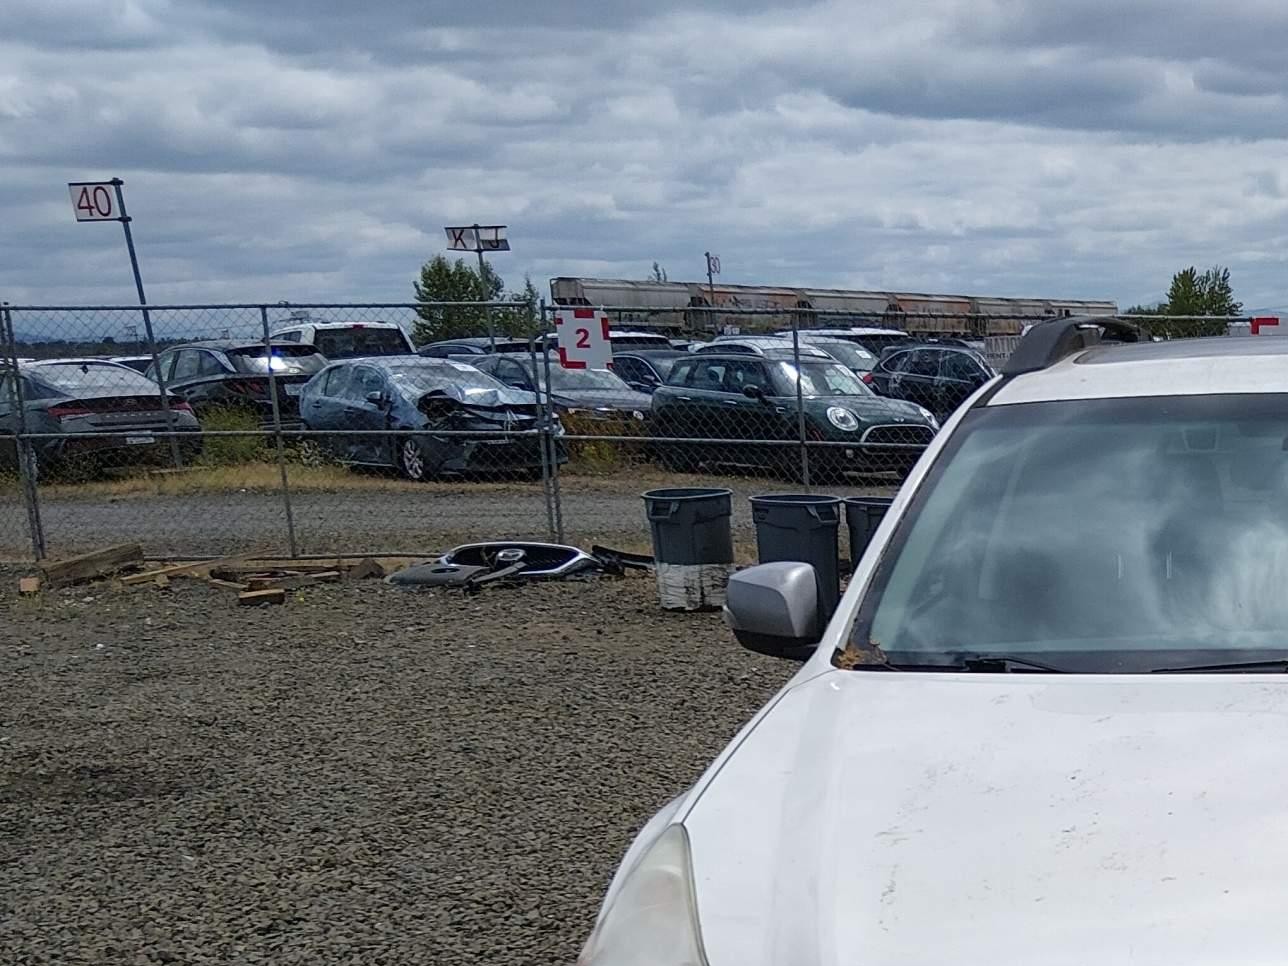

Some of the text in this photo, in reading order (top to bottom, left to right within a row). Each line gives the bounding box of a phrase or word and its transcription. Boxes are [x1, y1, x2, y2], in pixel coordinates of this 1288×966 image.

[77, 186, 111, 217] 40
[452, 229, 467, 248] K
[489, 228, 500, 249] J
[575, 328, 591, 348] 2
